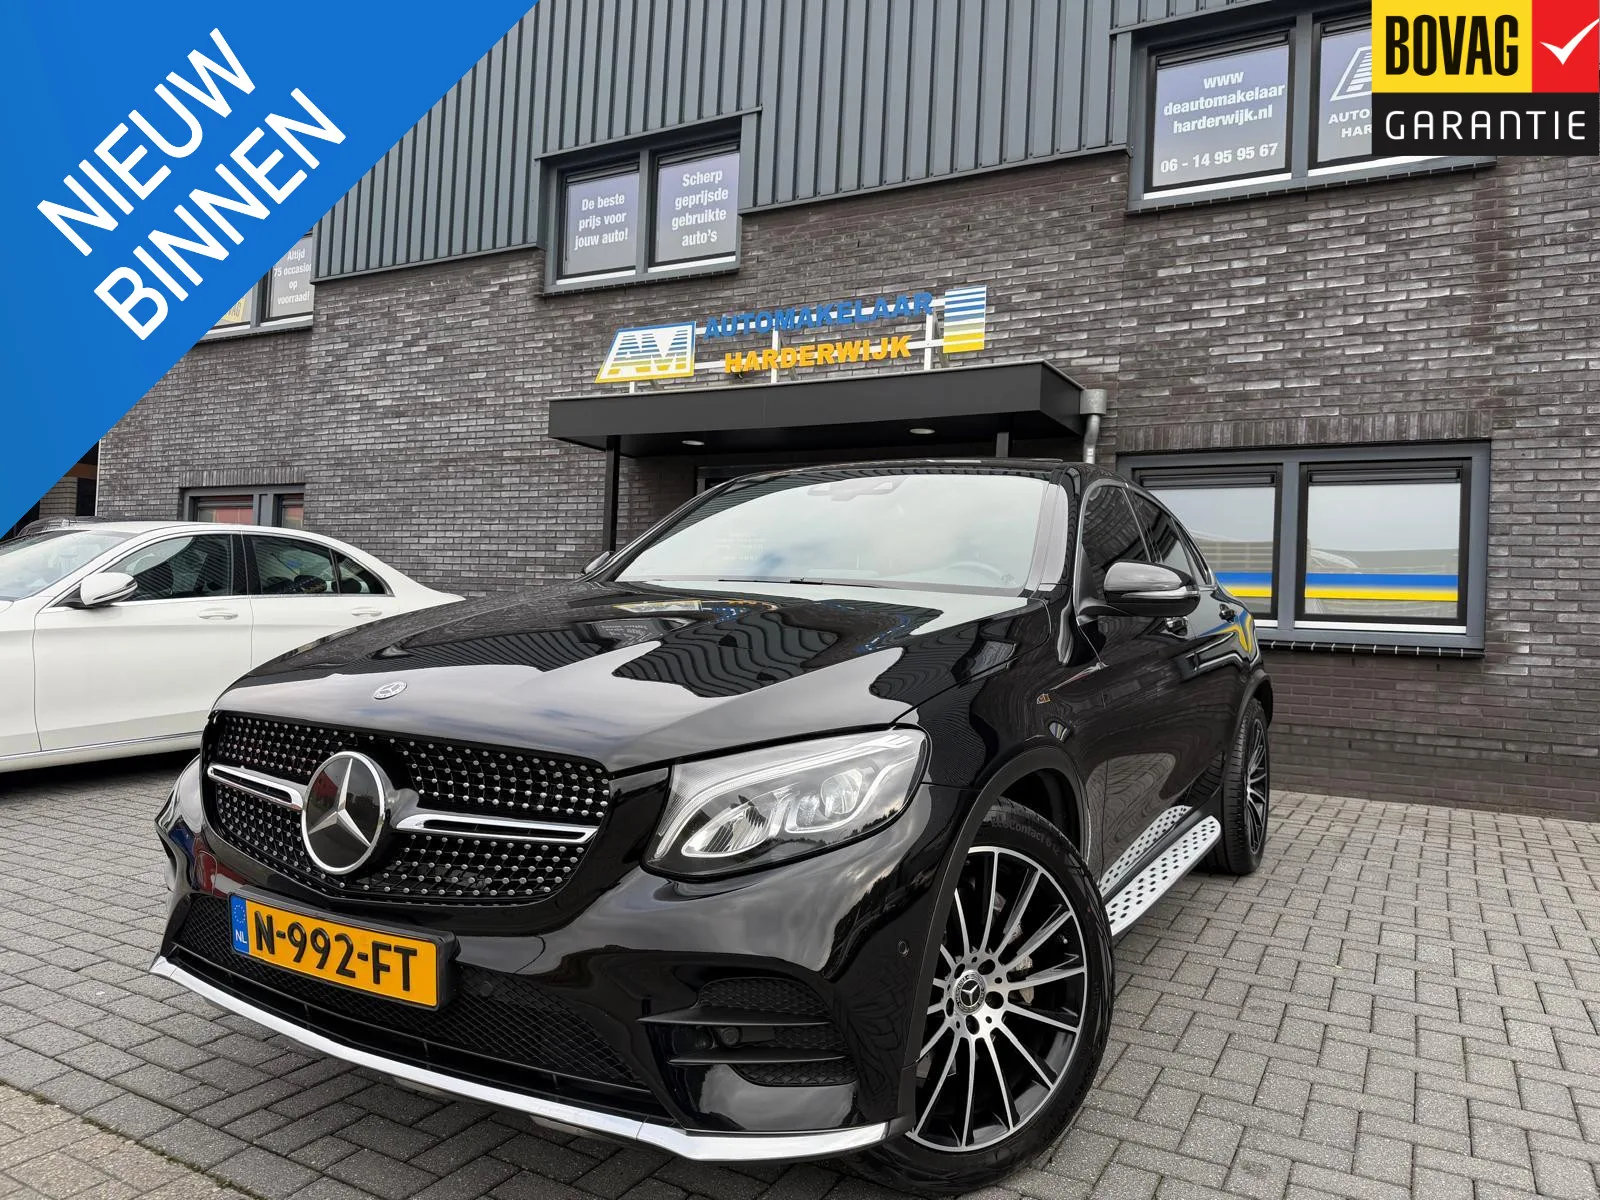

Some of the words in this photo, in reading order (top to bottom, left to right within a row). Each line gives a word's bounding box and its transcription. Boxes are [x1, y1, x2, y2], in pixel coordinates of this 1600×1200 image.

[1203, 71, 1244, 89] www
[1163, 84, 1286, 116] deautomakelaar
[1173, 104, 1273, 134] harderwijk.nl
[1160, 158, 1178, 173] 06
[1192, 153, 1210, 168] 14
[1214, 149, 1232, 165] 95
[1236, 145, 1255, 161] 95
[1259, 142, 1279, 157] 67
[682, 169, 723, 187] Scherp
[581, 198, 595, 211] De
[597, 193, 625, 209] beste
[675, 187, 729, 210] geprijsde
[578, 214, 601, 231] prijs
[604, 211, 627, 225] voor
[671, 207, 727, 230] gebruikte
[574, 234, 599, 250] jouw
[601, 228, 629, 243] auto!
[681, 229, 718, 247] auto's
[289, 280, 298, 291] op
[703, 291, 934, 339] AUTOMAKELAAR
[724, 334, 912, 374] HARDERWIJK
[235, 928, 247, 944] NL
[254, 911, 418, 992] N-992-FT
